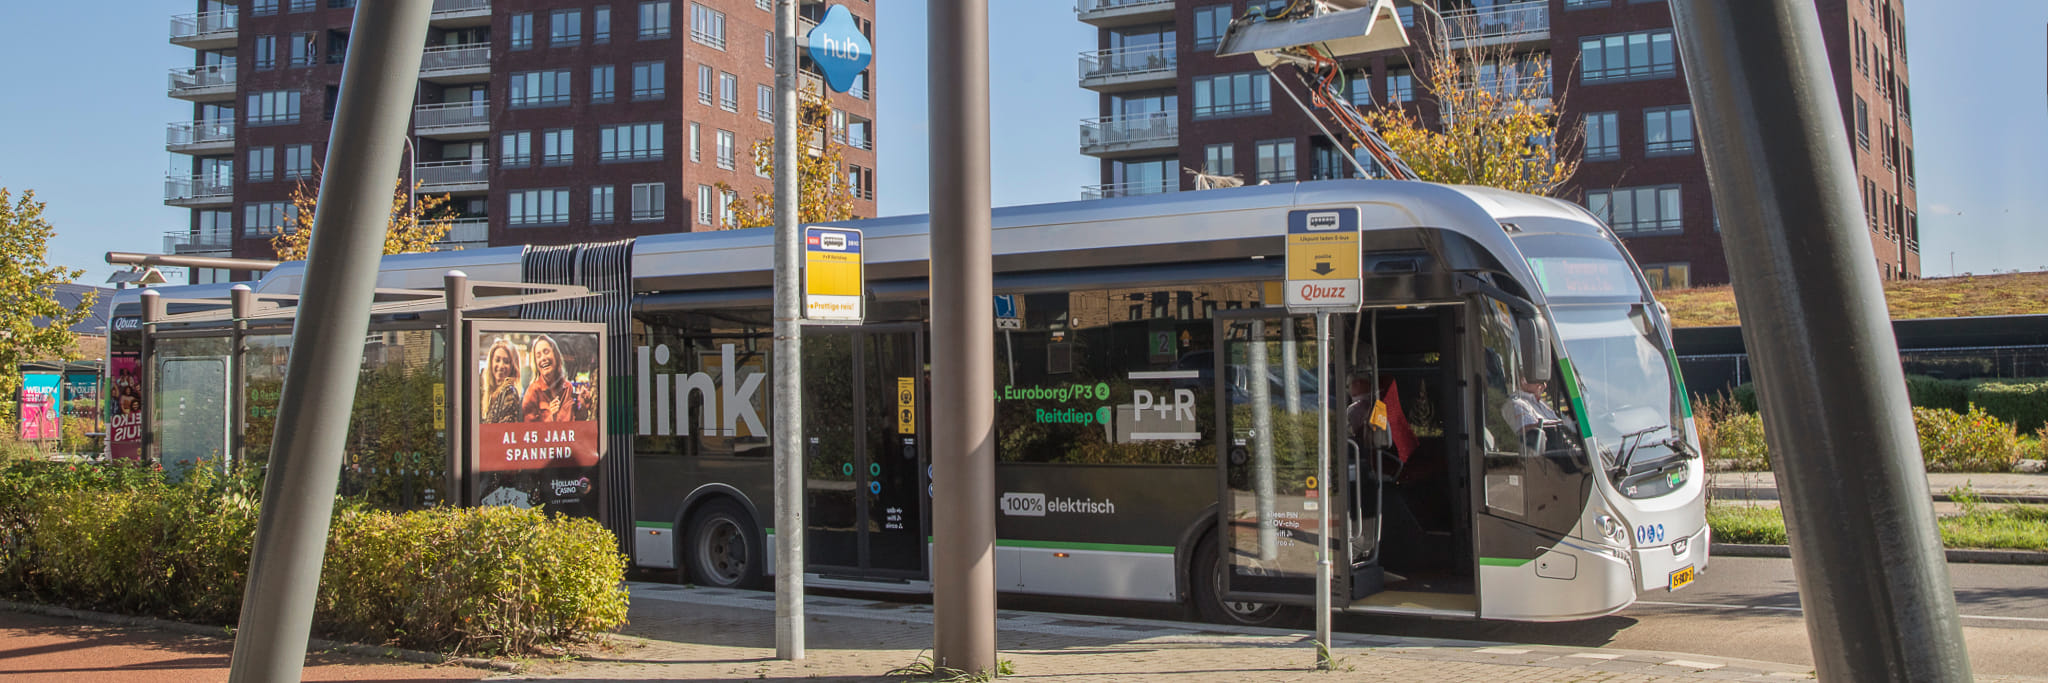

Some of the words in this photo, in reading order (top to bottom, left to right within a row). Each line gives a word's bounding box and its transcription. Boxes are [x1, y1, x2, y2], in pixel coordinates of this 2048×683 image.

[824, 33, 859, 60] hub
[1301, 284, 1346, 300] Qbuzz
[814, 301, 839, 311] Prettige
[115, 317, 138, 330] Qbuzz
[637, 343, 768, 437] link
[1005, 384, 1093, 403] Euroborg/P3
[1134, 388, 1195, 421] P+R
[1036, 408, 1093, 426] Reitdiep
[502, 431, 517, 444] AL
[523, 431, 538, 443] 45
[544, 430, 575, 442] JAAR
[506, 446, 572, 461] SPANNEND
[550, 479, 580, 490] HOLLAND
[555, 485, 577, 496] CASINO
[1006, 498, 1043, 512] 100%
[1047, 497, 1115, 513] elektrisch
[1273, 519, 1300, 528] OV-chip
